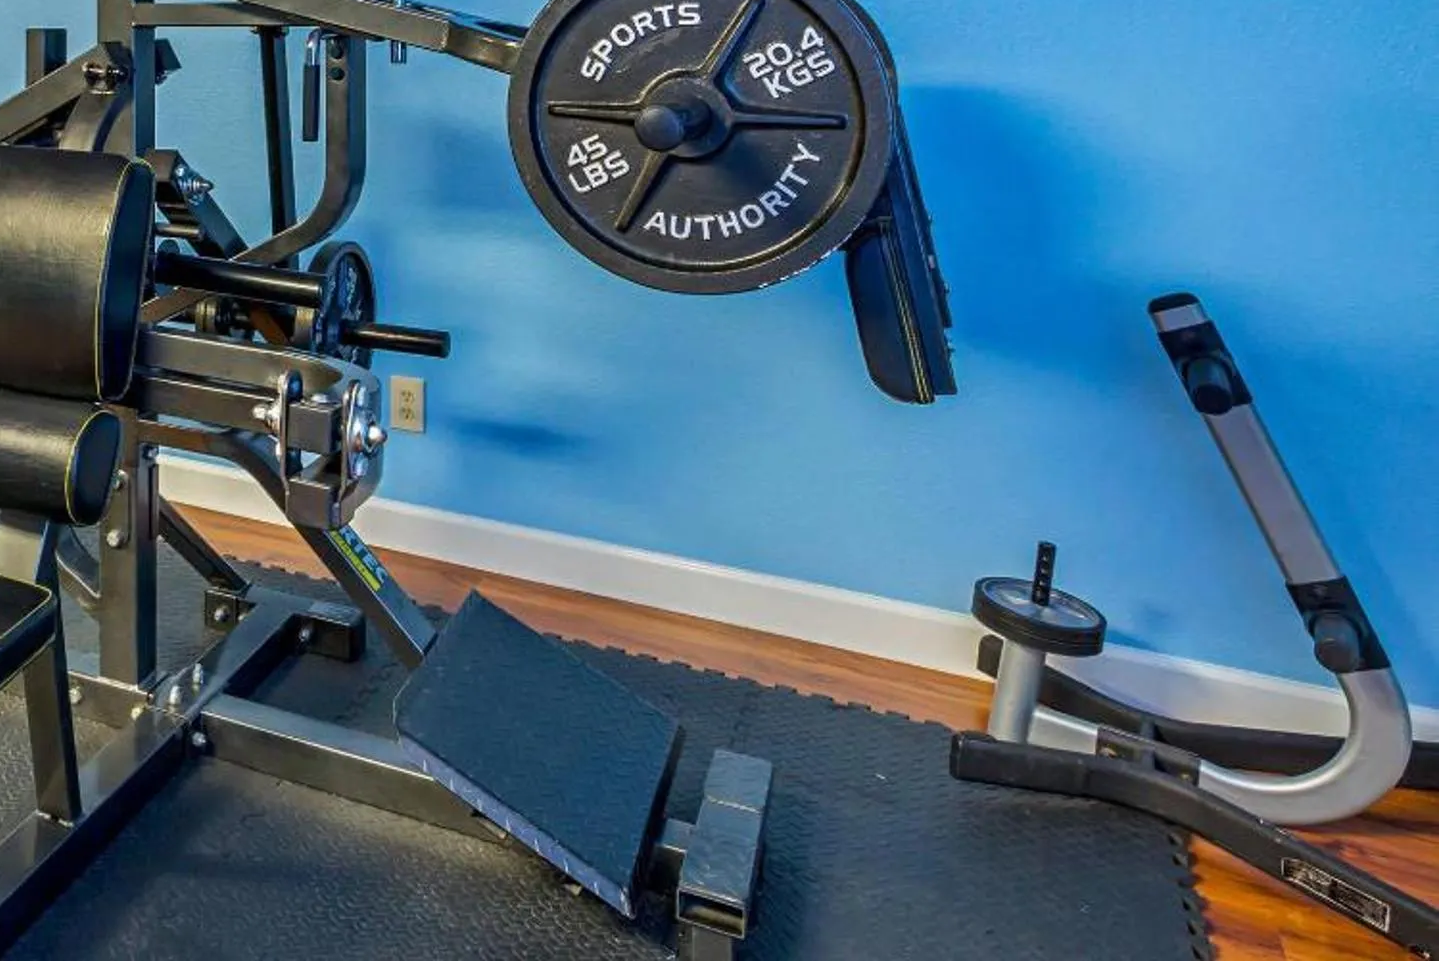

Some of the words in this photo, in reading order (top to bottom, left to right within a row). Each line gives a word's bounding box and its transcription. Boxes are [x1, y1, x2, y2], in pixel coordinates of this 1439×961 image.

[580, 1, 702, 82] SPORTS
[742, 25, 824, 79] 20.4
[761, 49, 835, 99] KGS
[567, 133, 608, 167] 45
[568, 149, 630, 193] LBS
[642, 142, 821, 241] AUTHORITY
